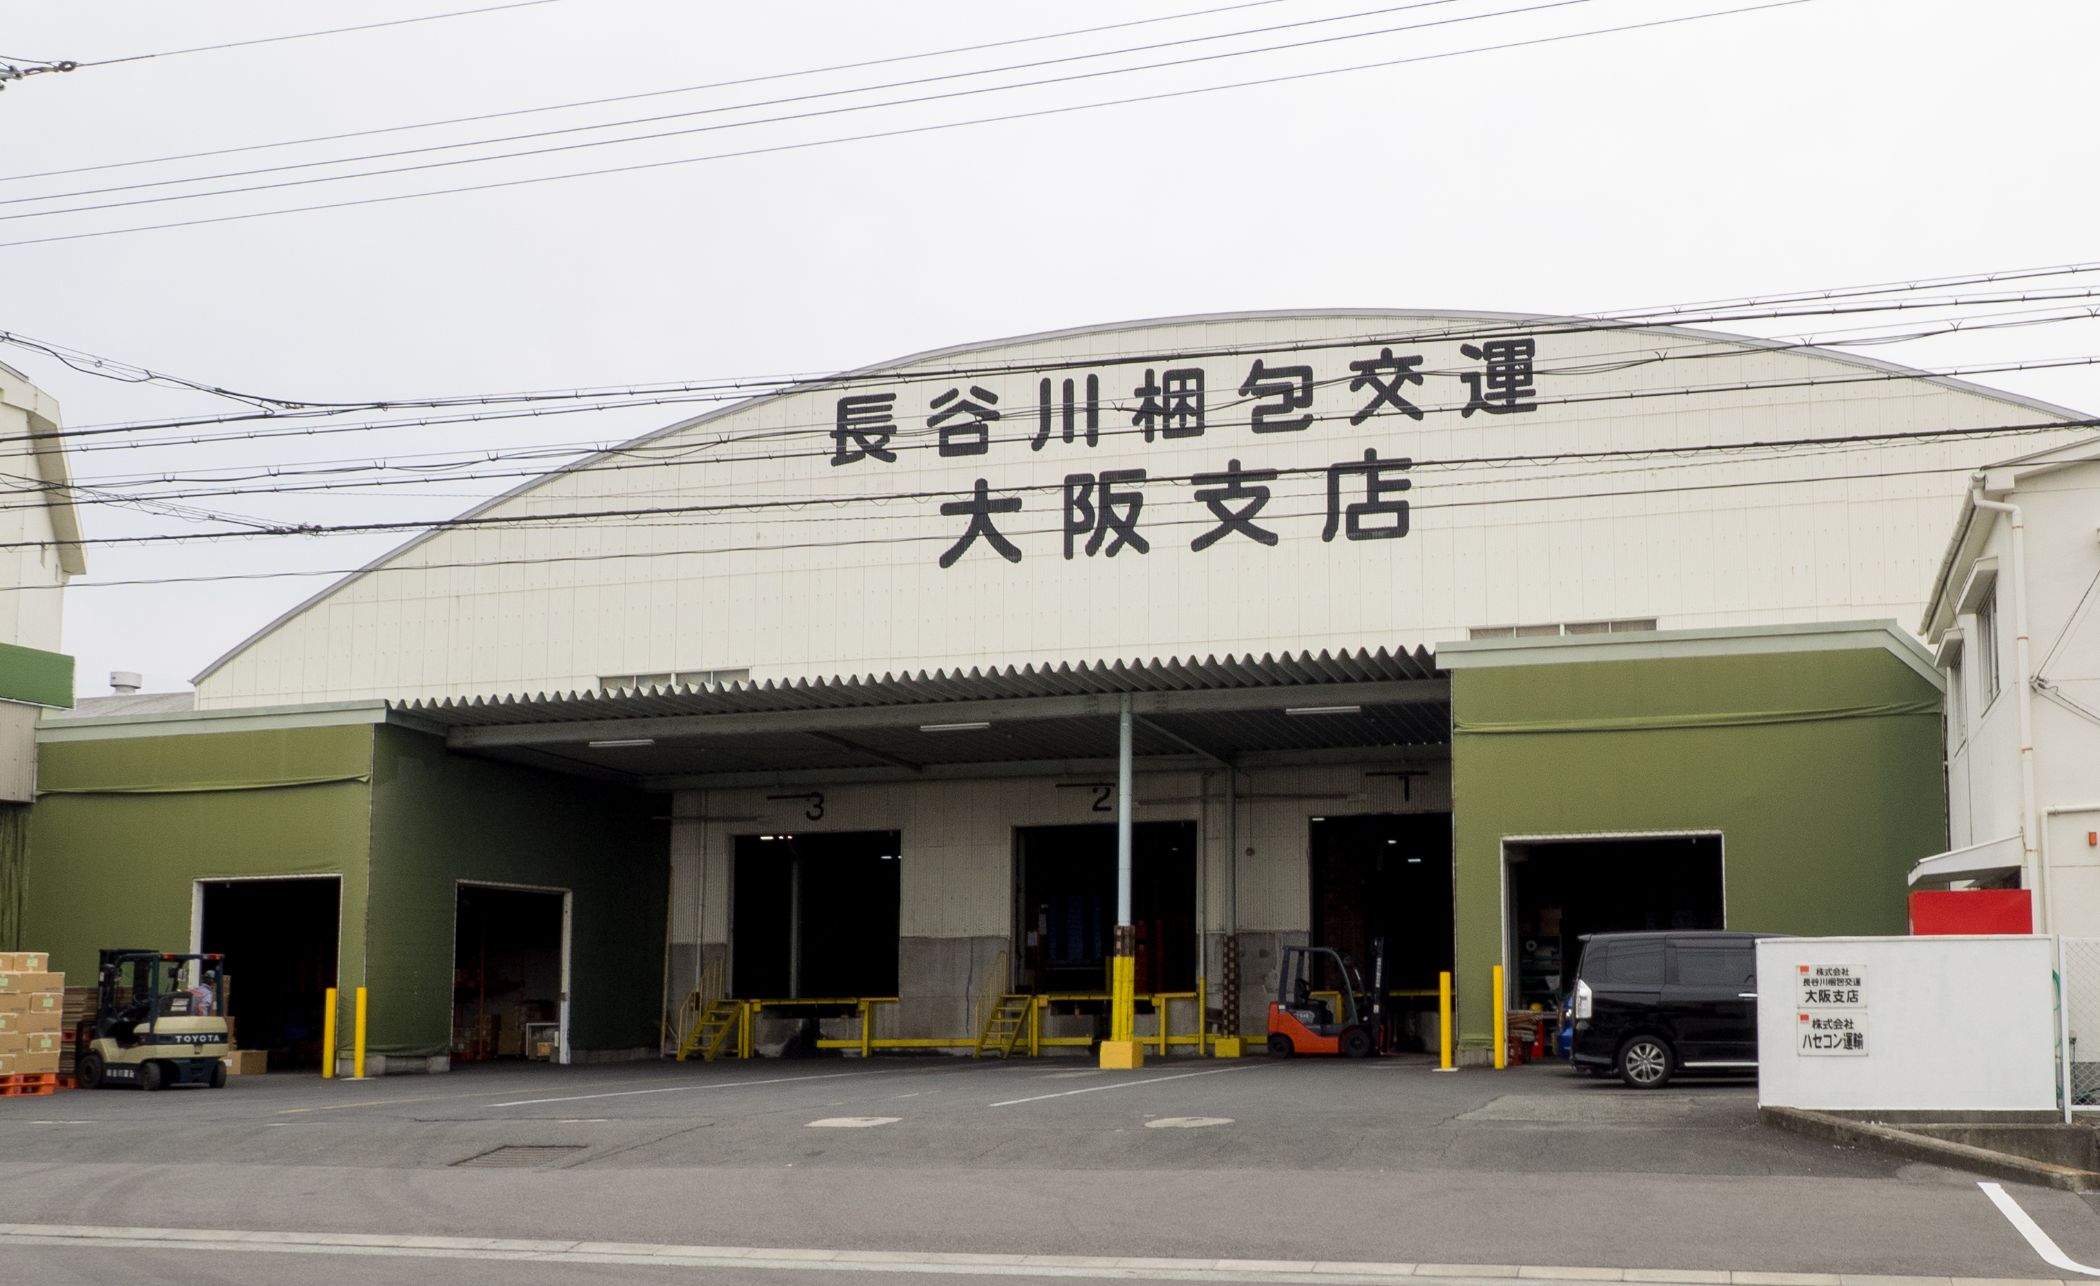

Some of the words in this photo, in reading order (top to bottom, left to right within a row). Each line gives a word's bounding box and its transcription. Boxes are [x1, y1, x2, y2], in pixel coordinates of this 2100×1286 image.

[830, 337, 1538, 466] 長谷川梱包交運
[938, 447, 1413, 569] 大阪支店
[806, 792, 824, 821] 3
[1092, 783, 1112, 812] 2
[1816, 967, 1849, 976] 株式会社
[1805, 989, 1859, 1003] 大阪支店
[1812, 1018, 1854, 1030] 株式会社
[175, 1034, 220, 1043] TOYOTA
[1803, 1032, 1864, 1050] ハセコン運輸
